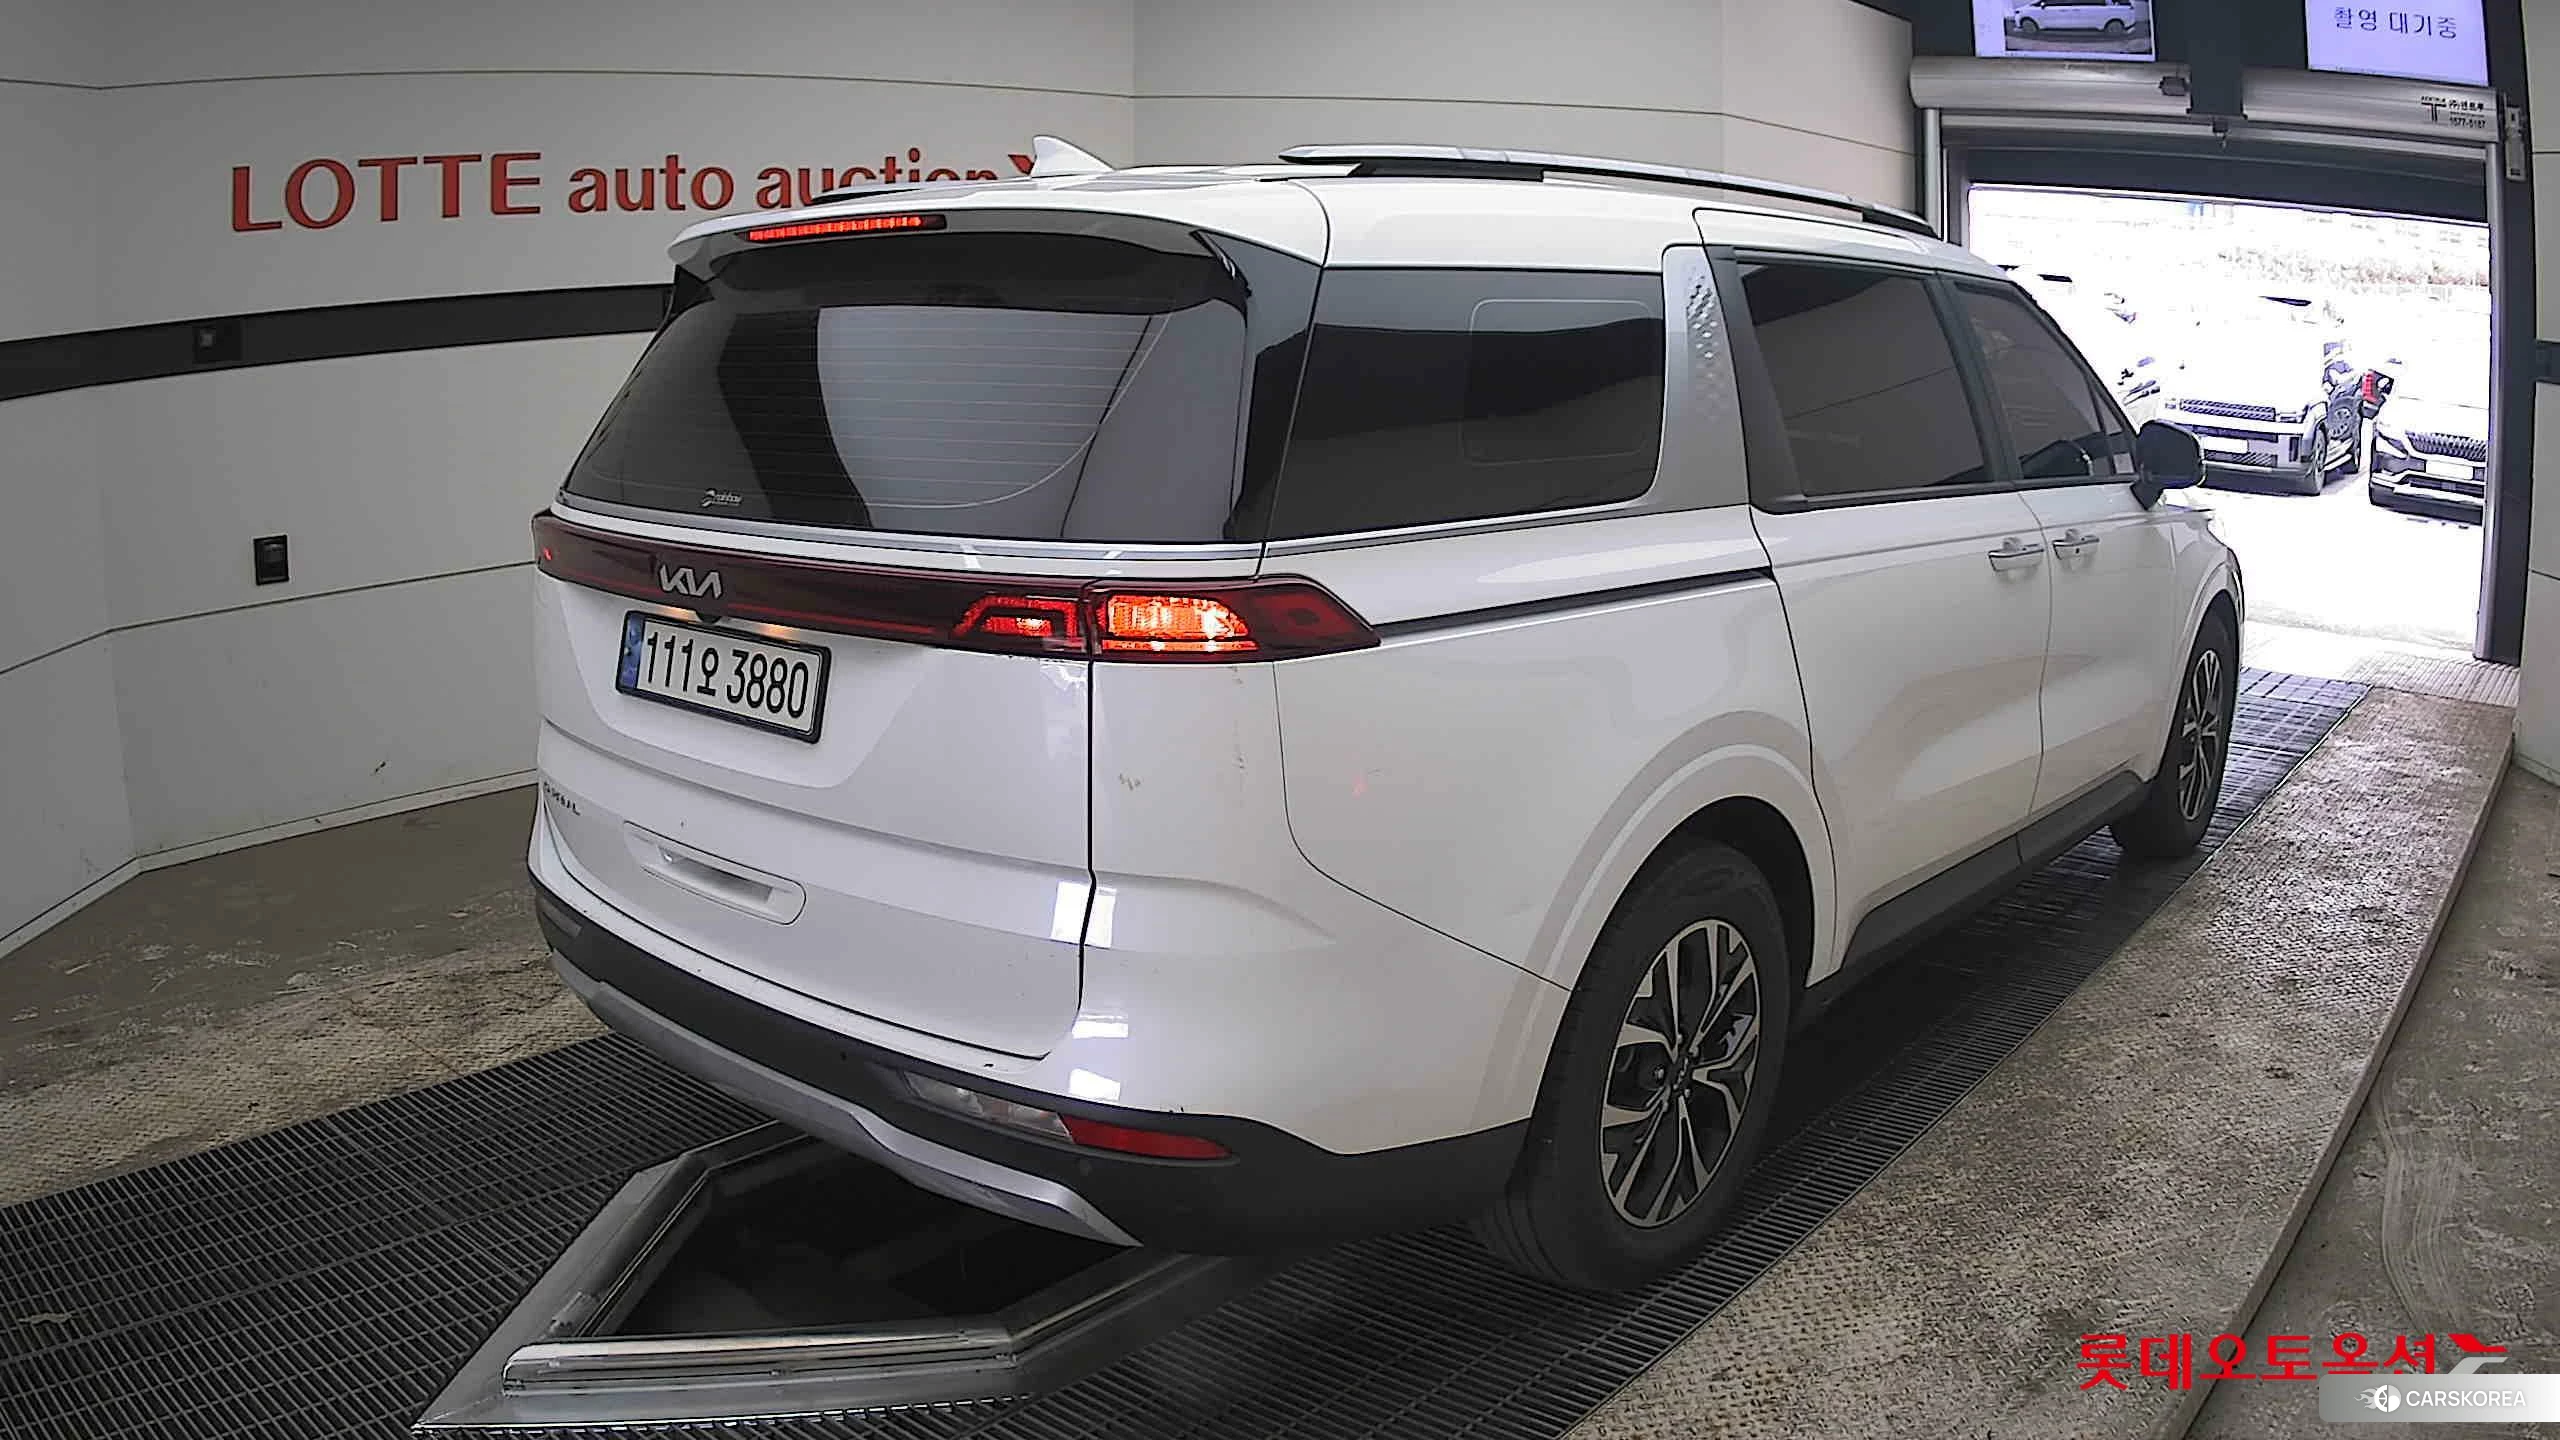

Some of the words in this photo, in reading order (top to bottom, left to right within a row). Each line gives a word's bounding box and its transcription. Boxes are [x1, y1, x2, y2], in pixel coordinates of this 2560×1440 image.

[2335, 7, 2377, 32] 촬영
[2389, 11, 2457, 39] 대기중
[232, 151, 542, 233] LOTTE
[568, 153, 735, 214] auto
